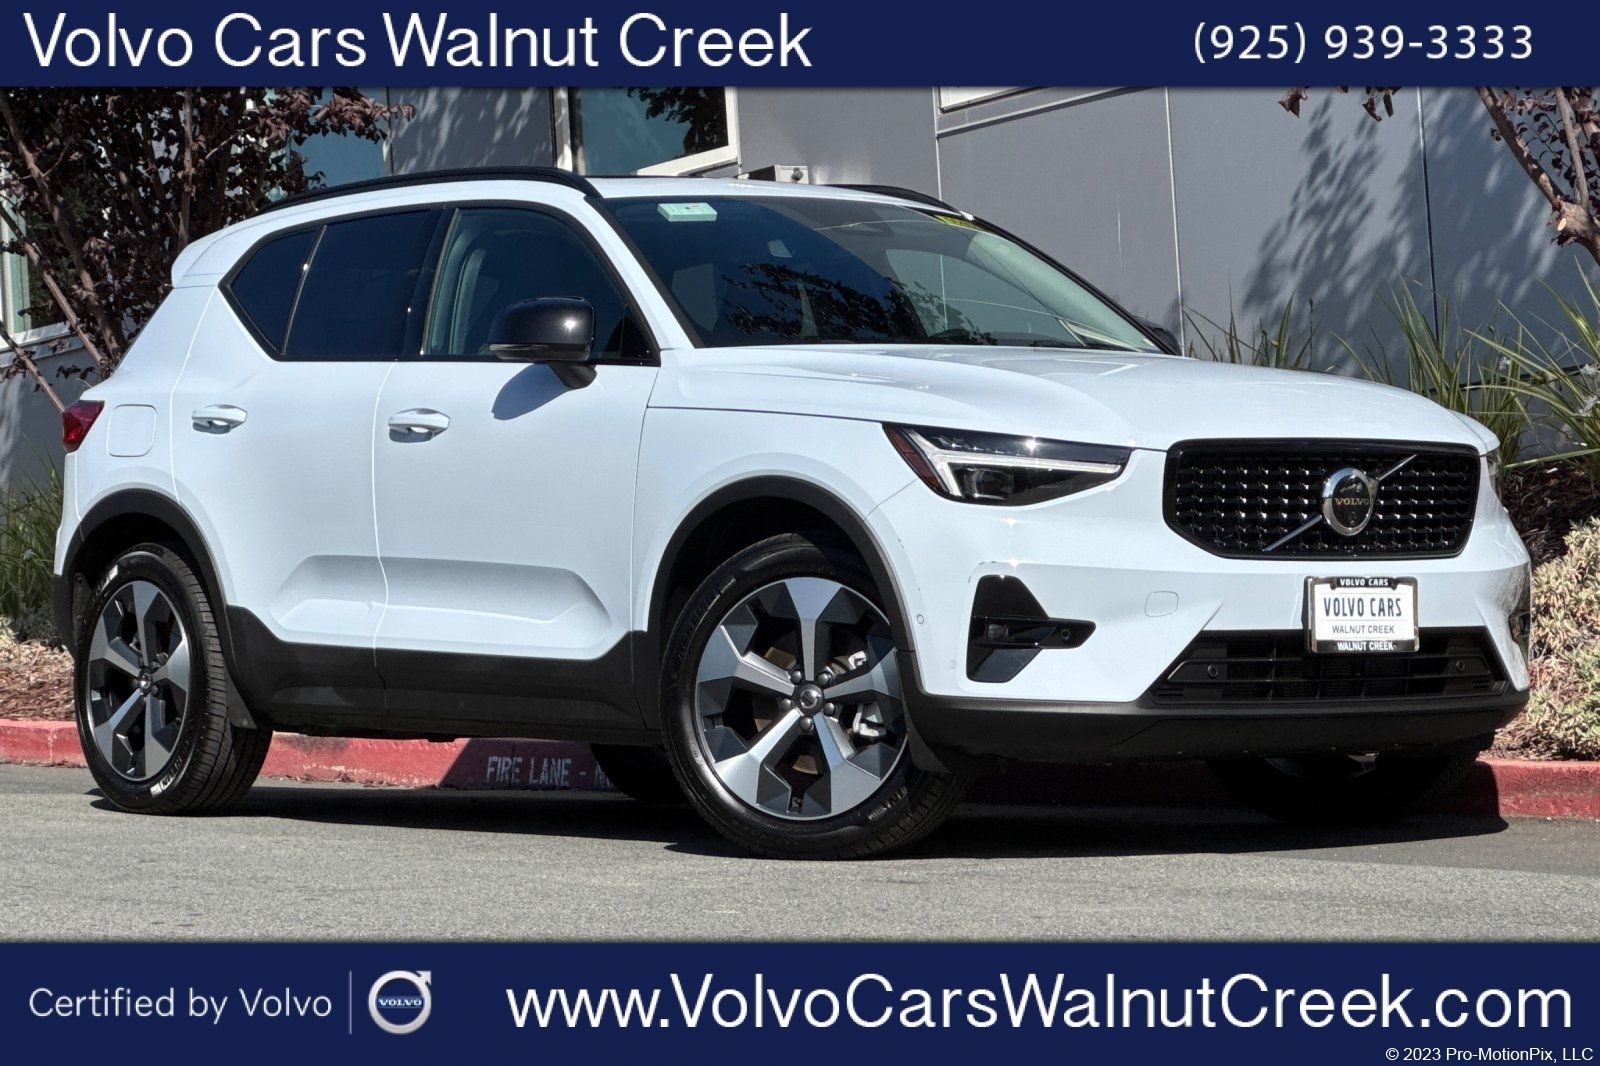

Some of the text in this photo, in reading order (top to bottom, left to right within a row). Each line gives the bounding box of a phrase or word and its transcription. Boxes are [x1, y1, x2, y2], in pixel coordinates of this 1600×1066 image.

[1340, 578, 1388, 586] VOLVO CARS
[1323, 597, 1402, 617] VOLVO CARS
[1332, 625, 1395, 634] WALNUT CREEK
[1337, 641, 1394, 651] WALNUT CREEK
[486, 756, 522, 784] FIRE
[529, 758, 571, 786] LANE
